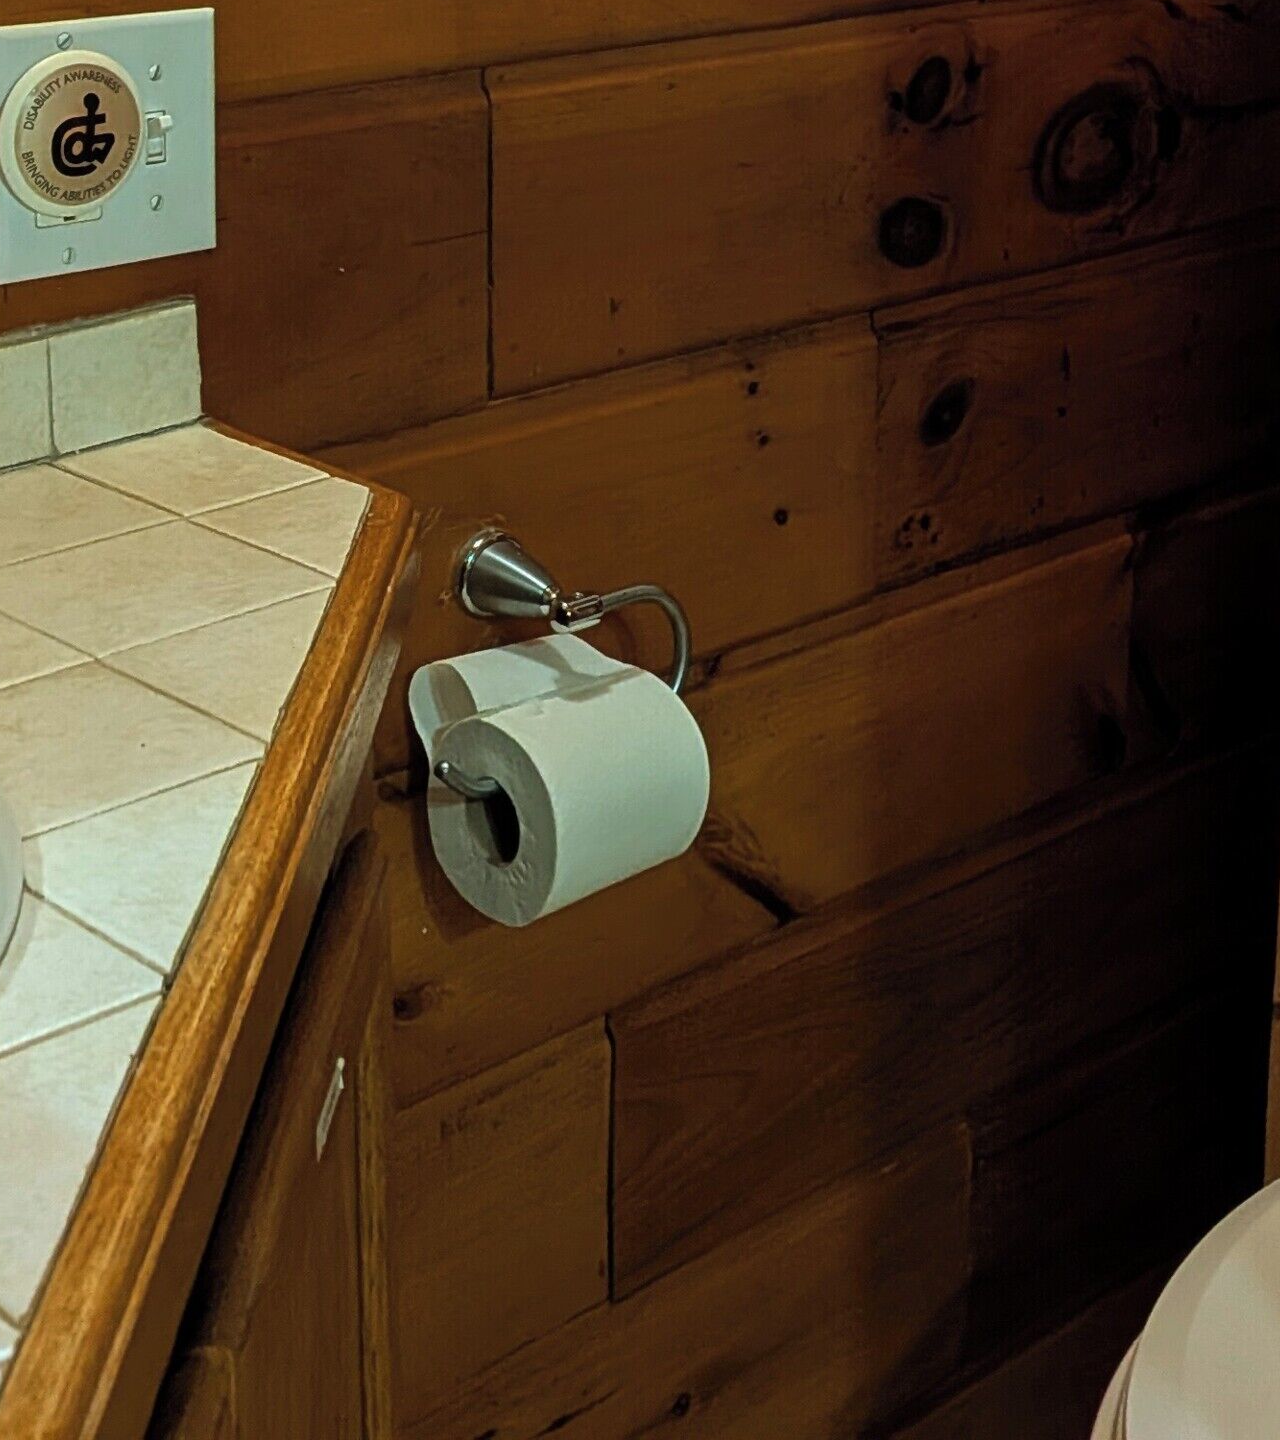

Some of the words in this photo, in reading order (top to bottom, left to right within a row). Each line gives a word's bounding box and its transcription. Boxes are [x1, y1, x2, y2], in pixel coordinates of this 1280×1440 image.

[23, 78, 61, 130] DISABILITY
[63, 70, 122, 94] AWARENESS
[22, 151, 61, 198] BRINGING
[107, 169, 122, 185] TO
[121, 135, 137, 170] LIGHT
